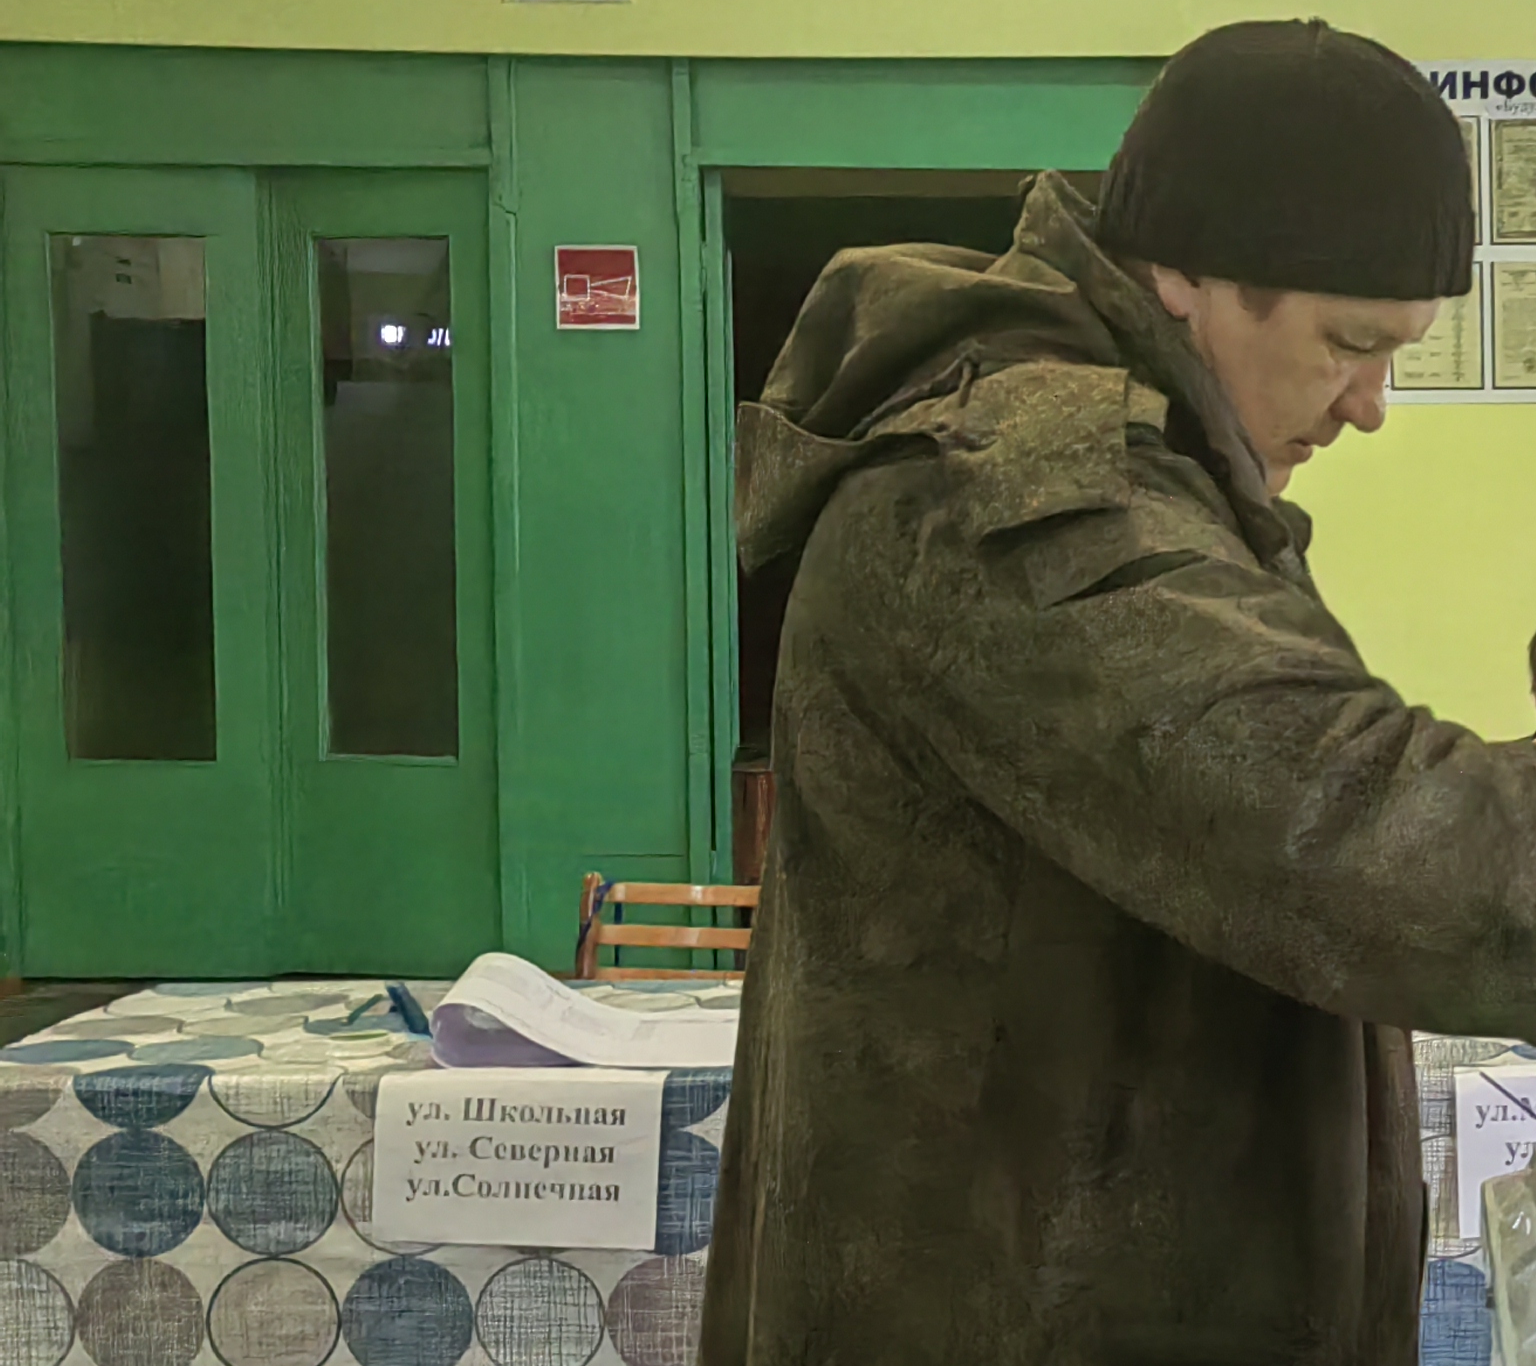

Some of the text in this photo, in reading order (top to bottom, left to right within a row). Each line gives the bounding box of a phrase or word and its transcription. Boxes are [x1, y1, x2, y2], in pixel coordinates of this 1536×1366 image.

[405, 1098, 625, 1126] ул. Школьная
[414, 1136, 614, 1168] ул. Северная
